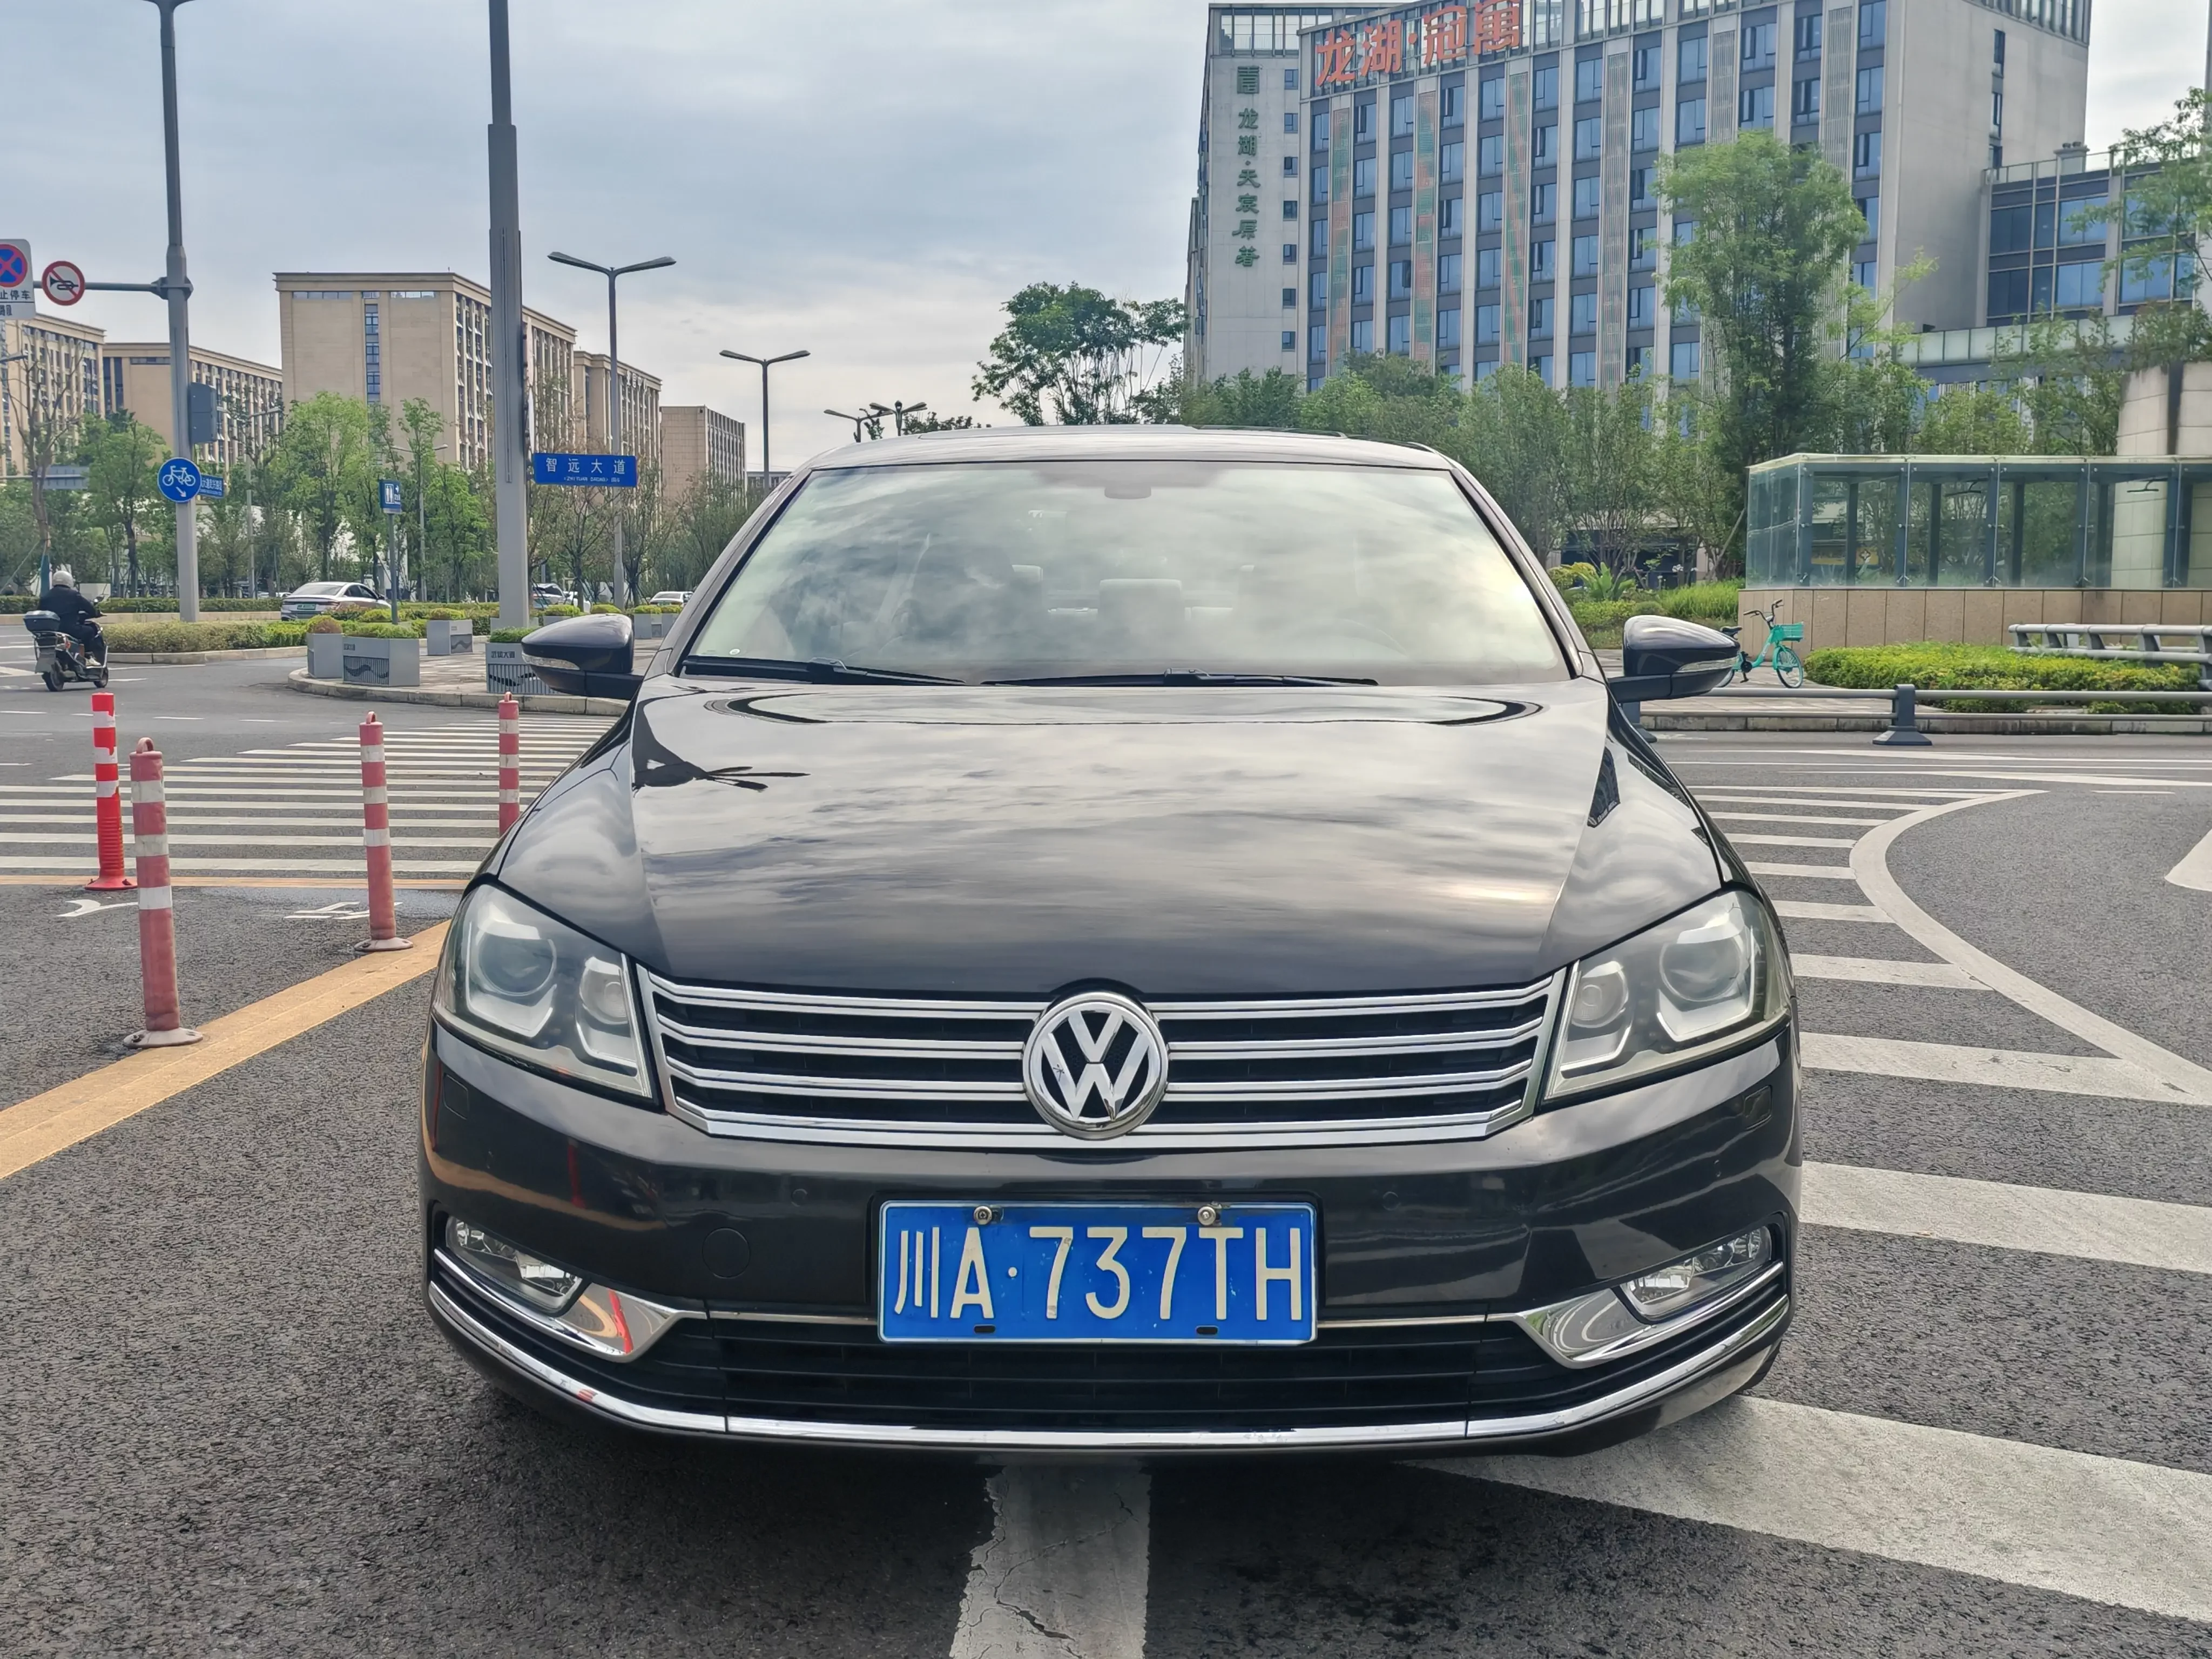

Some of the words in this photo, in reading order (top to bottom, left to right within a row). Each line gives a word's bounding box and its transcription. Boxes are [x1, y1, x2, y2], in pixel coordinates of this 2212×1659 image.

[1316, 0, 1520, 87] 龙湖·冠寓
[545, 457, 625, 474] 智远大道
